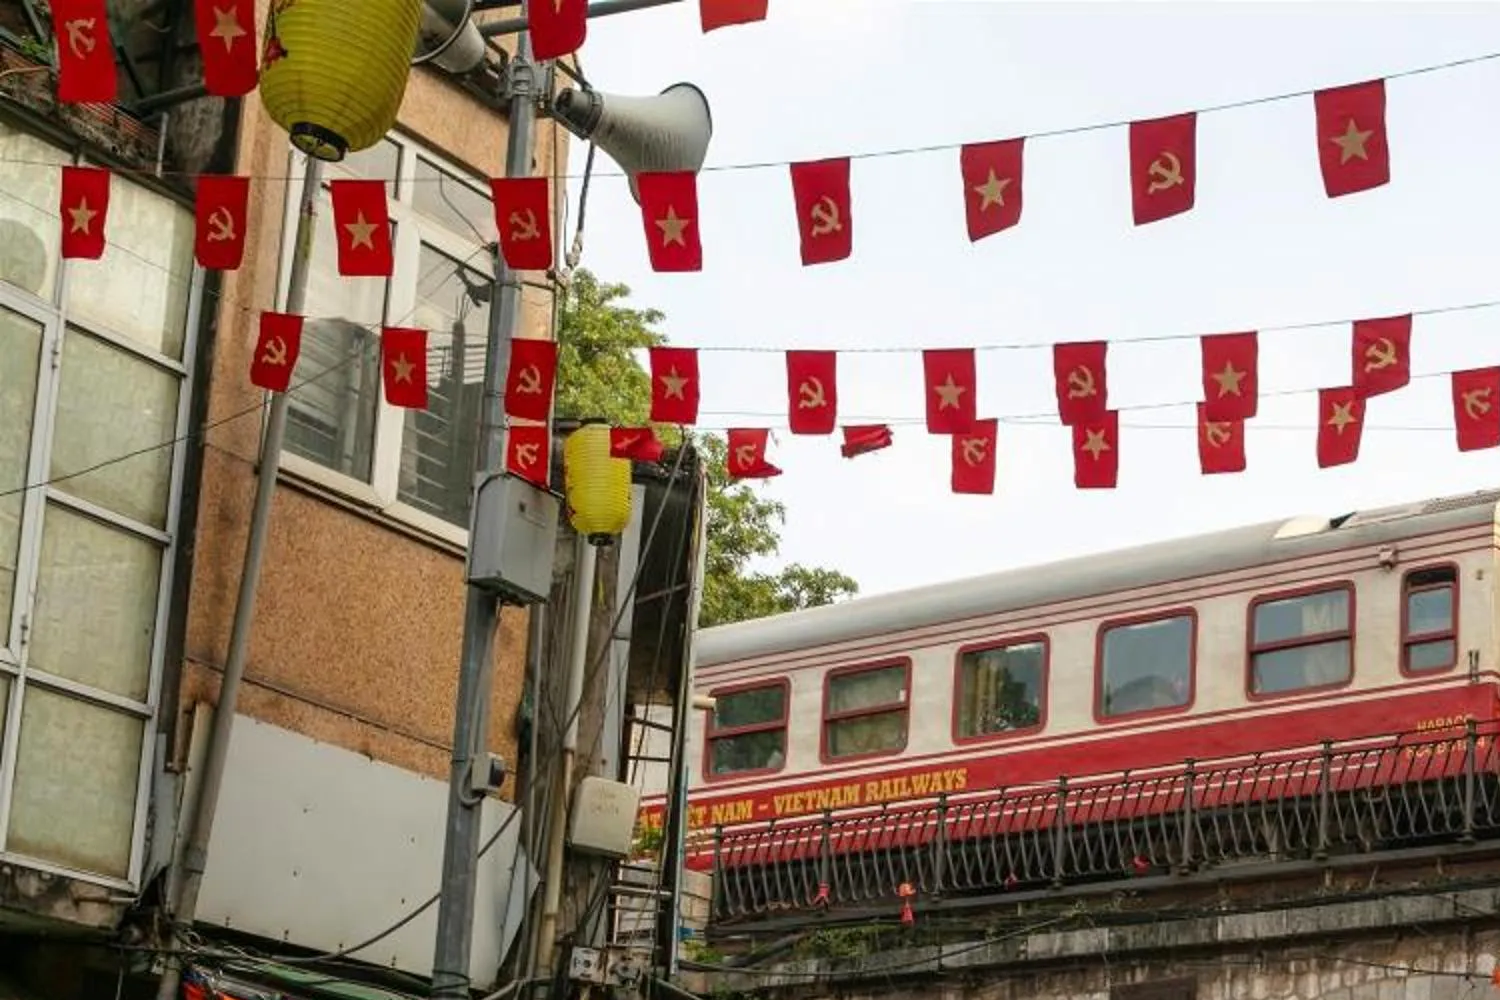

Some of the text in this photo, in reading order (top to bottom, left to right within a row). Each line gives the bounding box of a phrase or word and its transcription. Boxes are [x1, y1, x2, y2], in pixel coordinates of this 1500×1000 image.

[711, 799, 753, 825] NAM
[773, 784, 861, 816] VIETNAM
[865, 768, 968, 803] RAILWAYS
